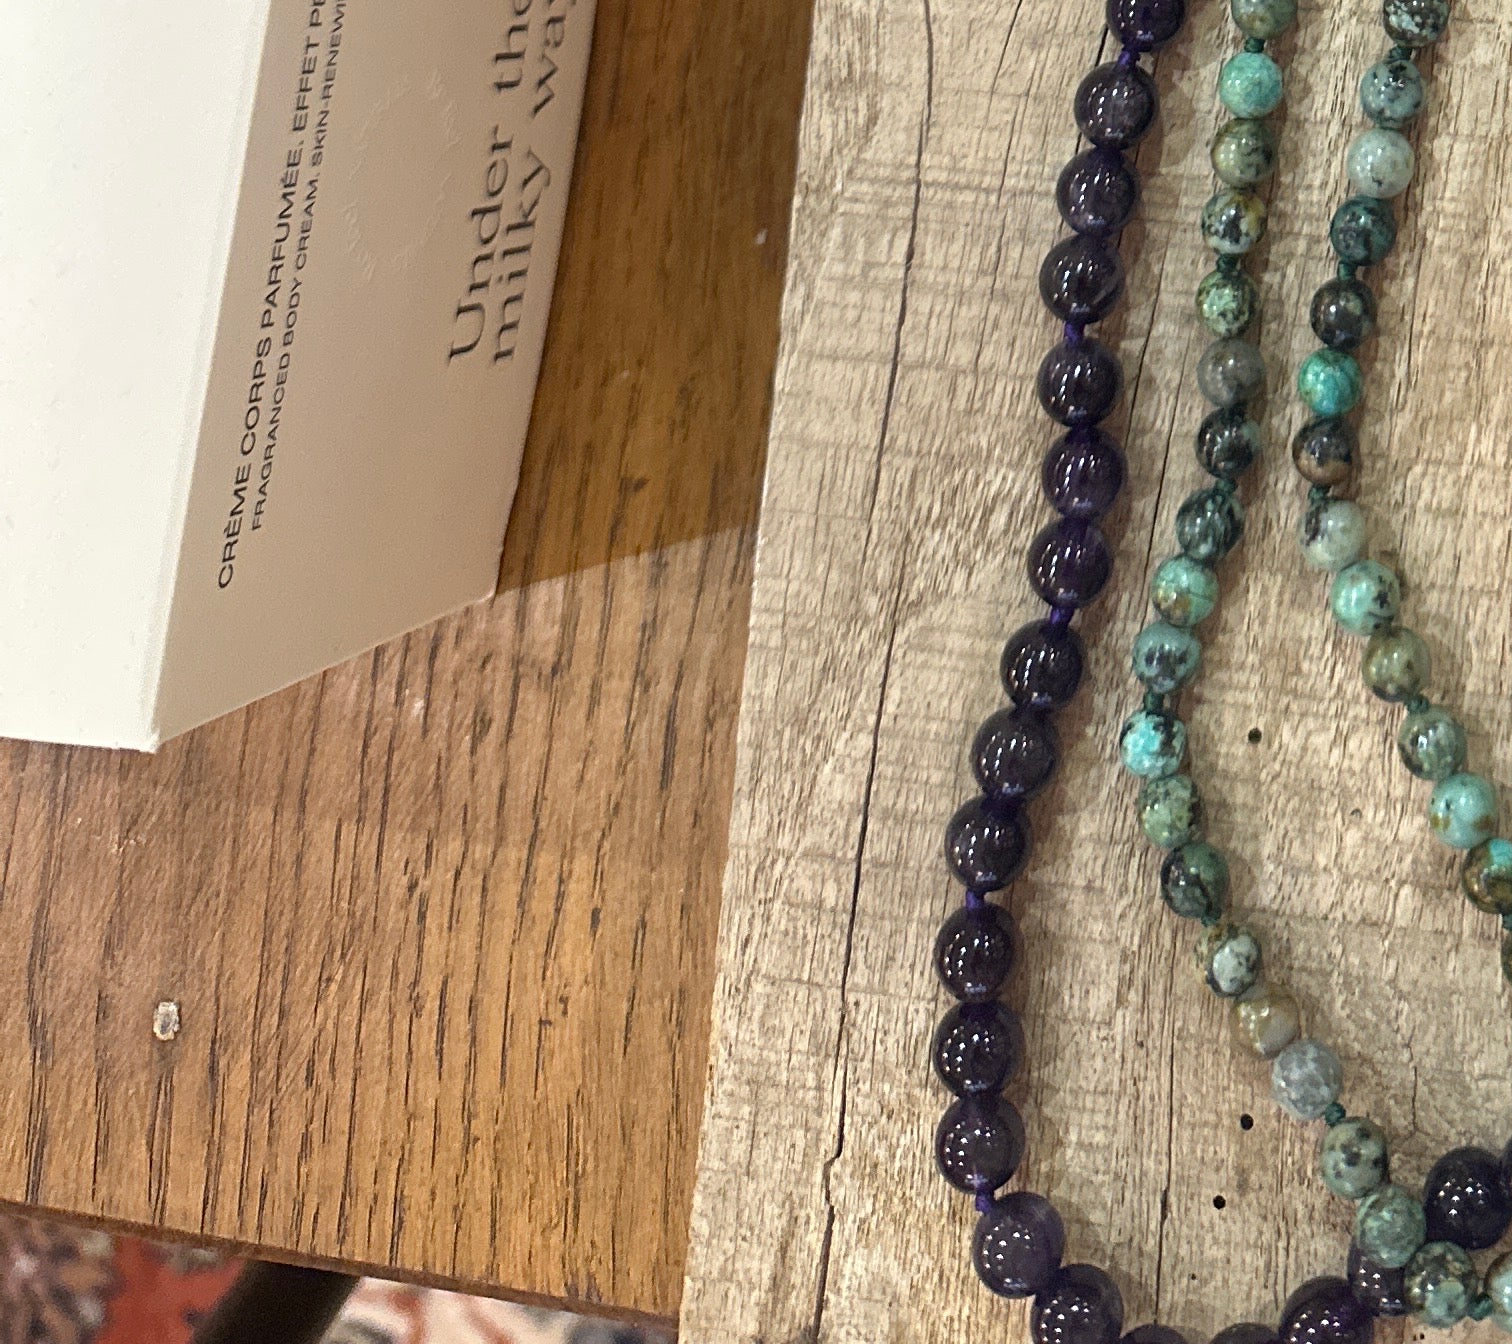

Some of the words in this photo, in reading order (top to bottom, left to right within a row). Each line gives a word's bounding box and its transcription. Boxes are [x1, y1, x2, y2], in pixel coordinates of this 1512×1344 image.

[218, 463, 251, 589] CRÈME
[241, 336, 271, 455] CORPS
[261, 140, 304, 329] PARFUMÉE.
[293, 35, 320, 132] EFFET
[252, 353, 291, 531] FRAGRANCED
[283, 277, 303, 346] BODY
[295, 171, 320, 270] CREAM.
[448, 124, 514, 366] Under
[494, 145, 551, 366] milky
